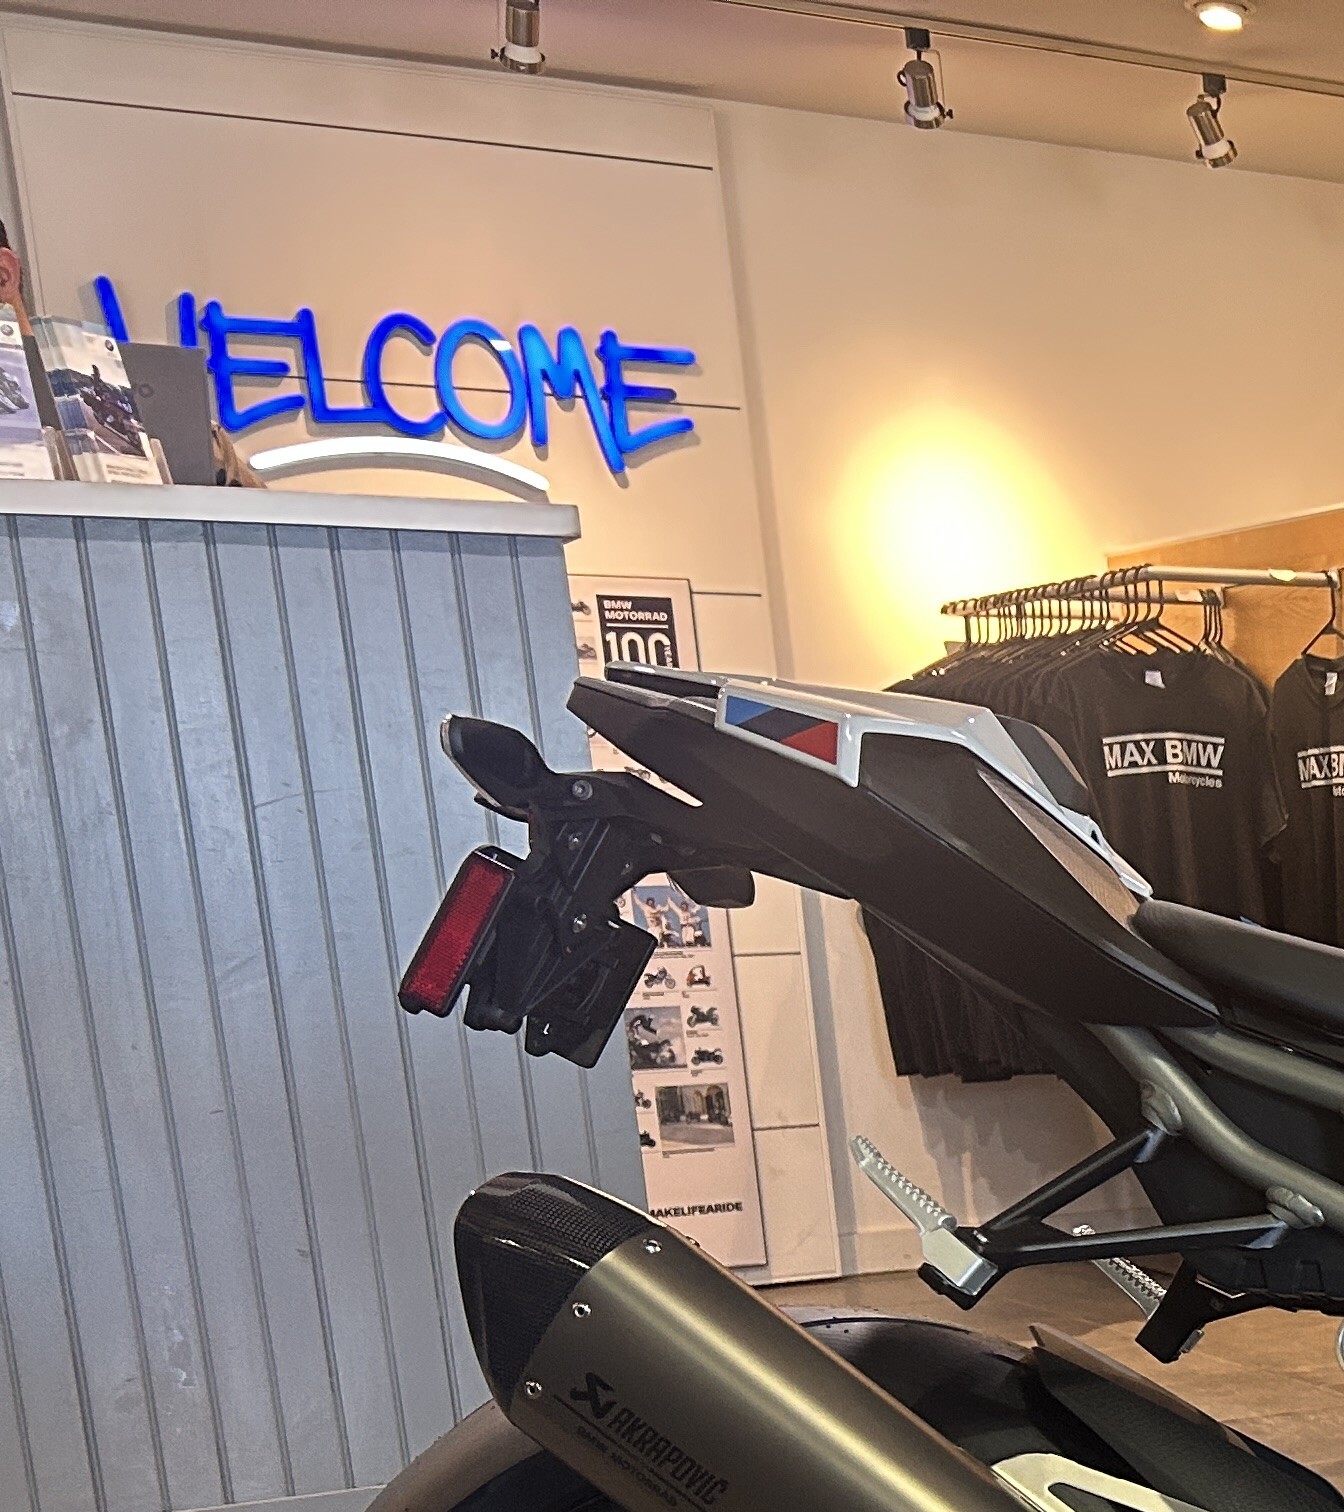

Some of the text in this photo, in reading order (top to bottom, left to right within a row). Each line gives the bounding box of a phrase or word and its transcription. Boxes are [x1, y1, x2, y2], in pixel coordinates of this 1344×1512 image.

[603, 599, 632, 610] BMW
[604, 610, 668, 621] MOTORRAD
[1103, 739, 1225, 769] MAX BMW
